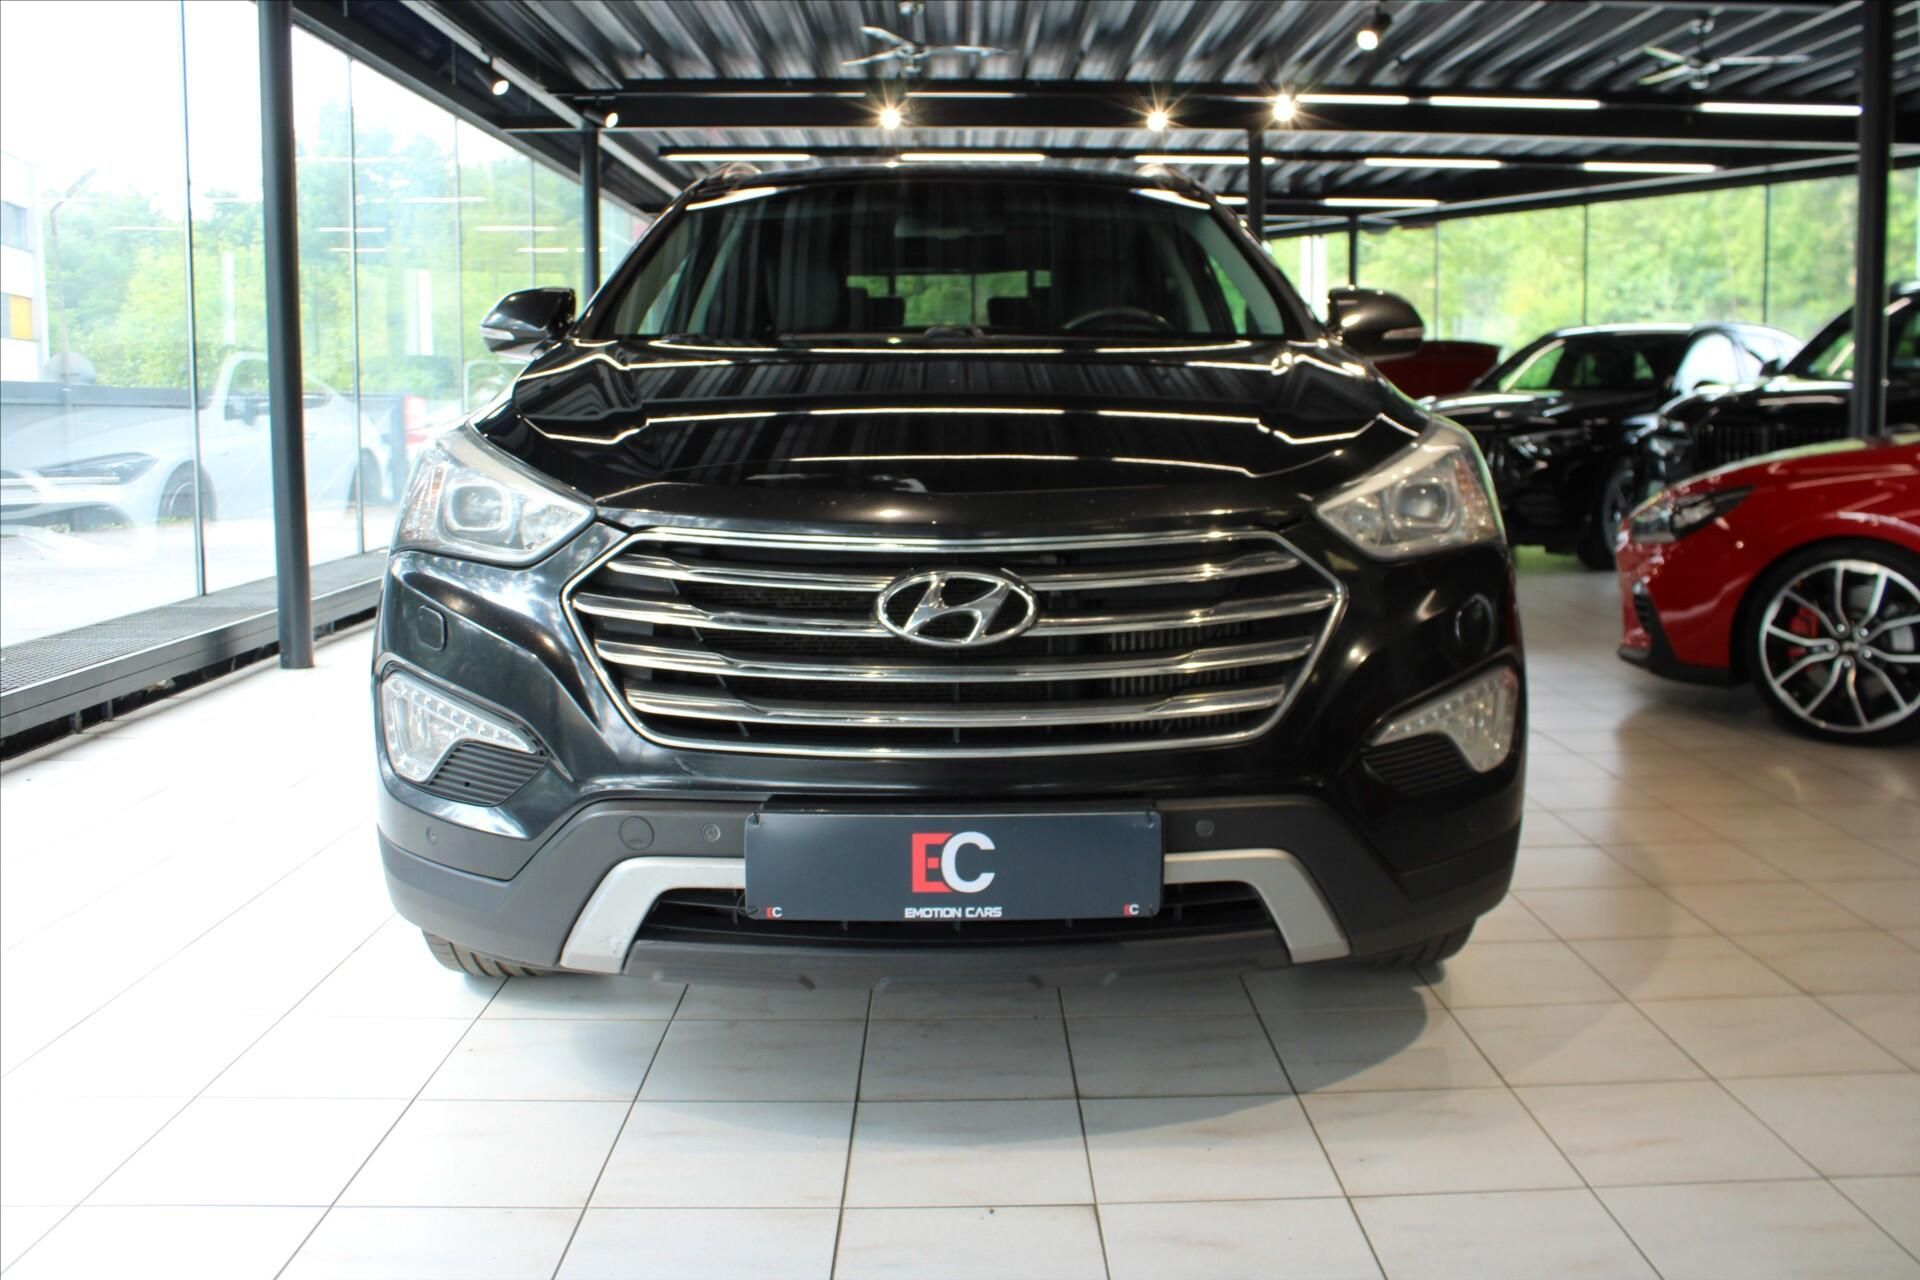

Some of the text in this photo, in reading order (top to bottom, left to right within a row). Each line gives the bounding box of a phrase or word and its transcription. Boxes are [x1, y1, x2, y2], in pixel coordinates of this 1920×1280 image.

[912, 831, 996, 893] EC
[904, 906, 1003, 918] EMOTION CARS
